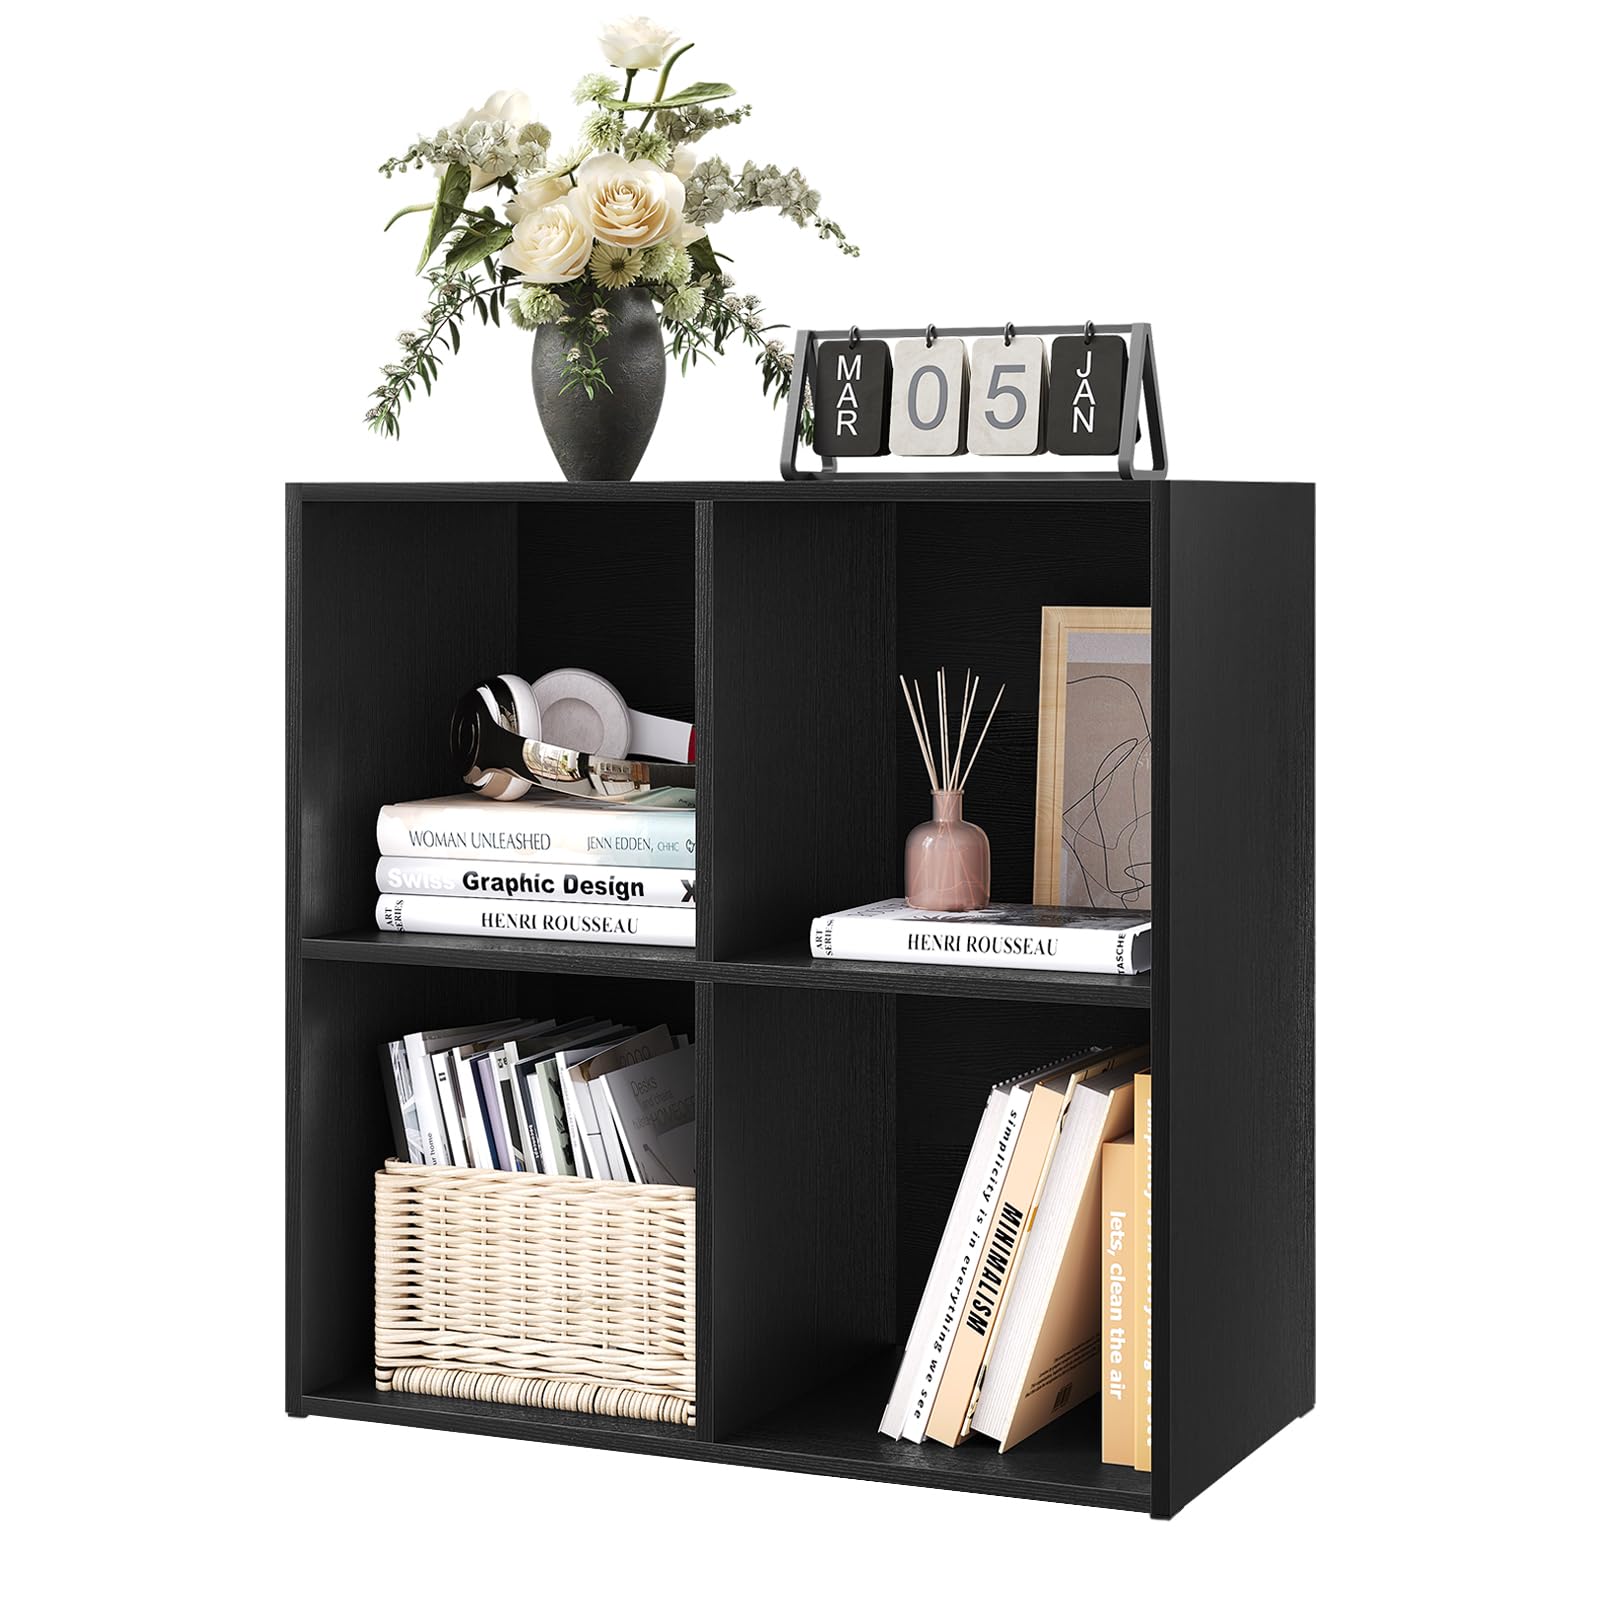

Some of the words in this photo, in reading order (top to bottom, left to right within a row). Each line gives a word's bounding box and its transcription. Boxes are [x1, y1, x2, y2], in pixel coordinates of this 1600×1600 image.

[836, 354, 862, 436] MAR
[1072, 351, 1096, 433] JAN
[409, 830, 467, 847] WOMAN
[471, 832, 551, 850] UNLEASHED
[587, 836, 612, 851] JENN
[615, 837, 653, 853] EDDEN,
[388, 867, 455, 889] Swiss
[462, 871, 555, 896] Graphic
[563, 874, 645, 900] Design
[385, 907, 394, 926] ART
[394, 900, 404, 932] SERIES
[481, 913, 538, 929] HENRI
[543, 915, 639, 934] ROUSSEAU
[815, 930, 823, 950] ART
[824, 919, 834, 956] SERIES
[908, 934, 962, 952] HENRI
[966, 936, 1058, 957] ROUSSEAU
[982, 1109, 1017, 1202] simplicity
[976, 1209, 987, 1224] is
[968, 1231, 980, 1248] in
[1107, 1211, 1126, 1257] lets,
[966, 1202, 1024, 1336] MINIMALISM
[934, 1255, 970, 1353] everything
[1110, 1263, 1126, 1321] clean
[1110, 1327, 1126, 1364] the
[925, 1359, 938, 1383] we
[1110, 1369, 1126, 1400] air
[914, 1389, 928, 1419] see
